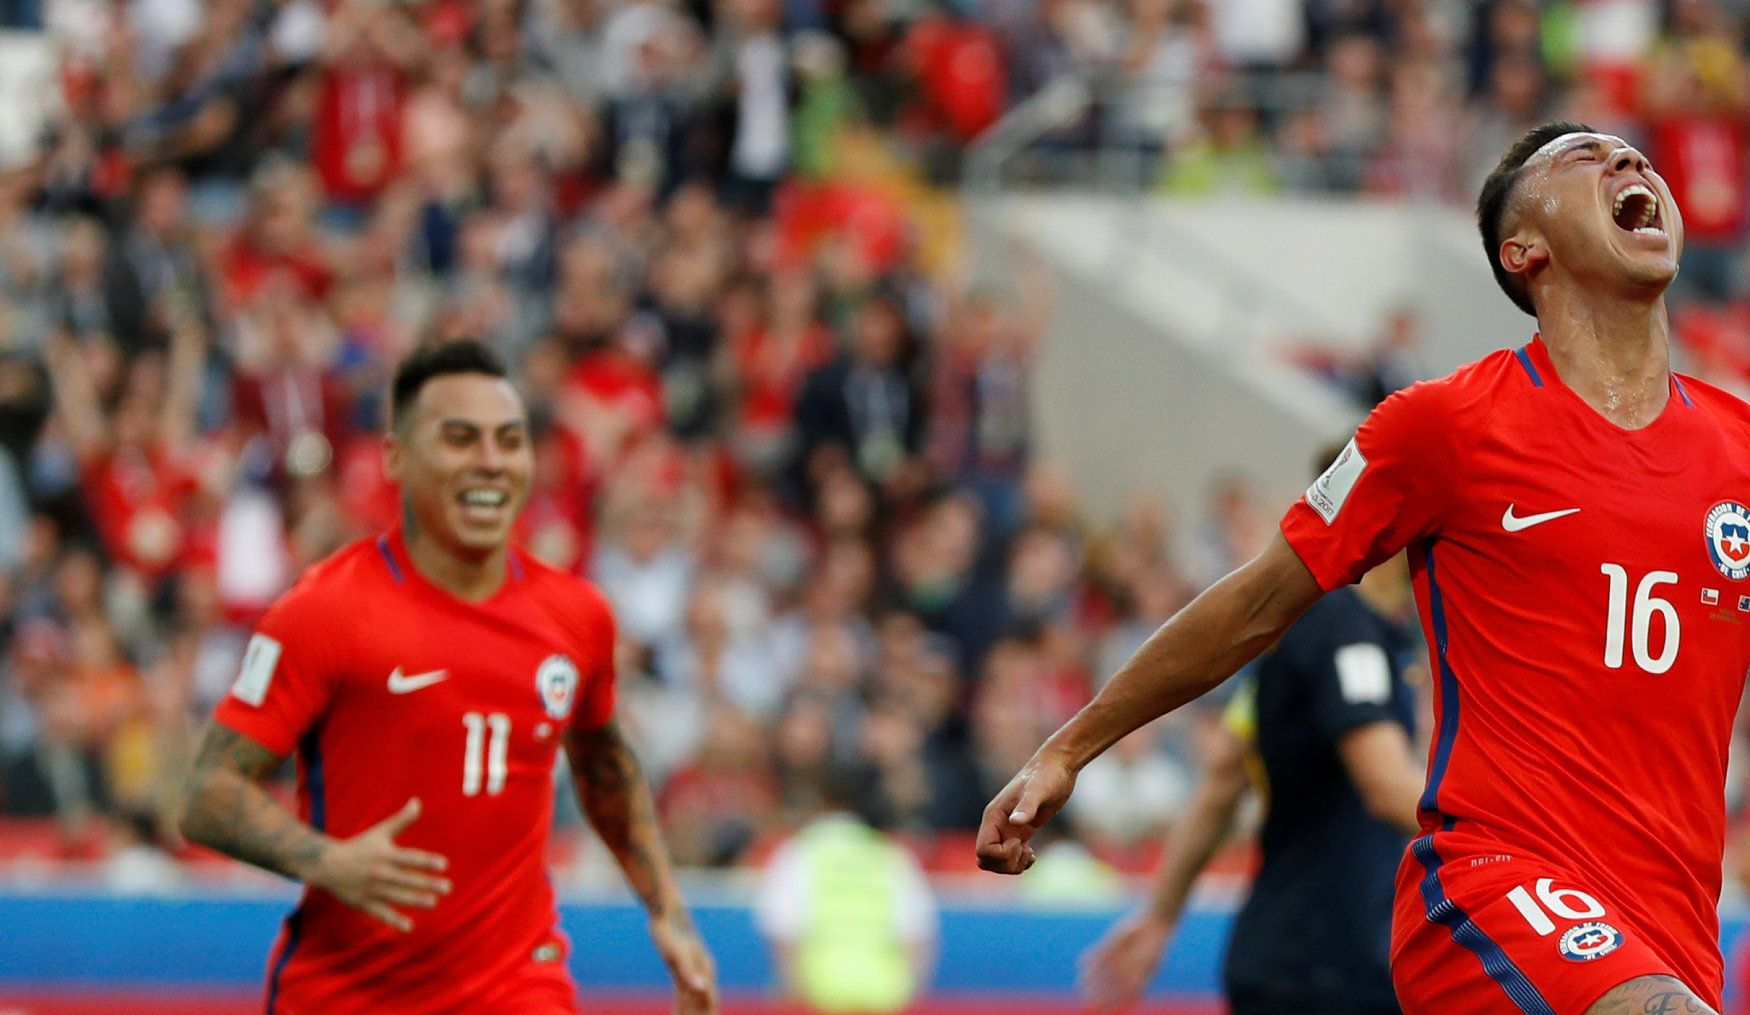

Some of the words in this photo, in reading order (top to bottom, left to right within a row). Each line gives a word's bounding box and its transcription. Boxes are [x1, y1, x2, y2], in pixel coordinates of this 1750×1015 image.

[1600, 563, 1681, 675] 16
[461, 711, 513, 797] 11
[1506, 878, 1606, 936] 16
